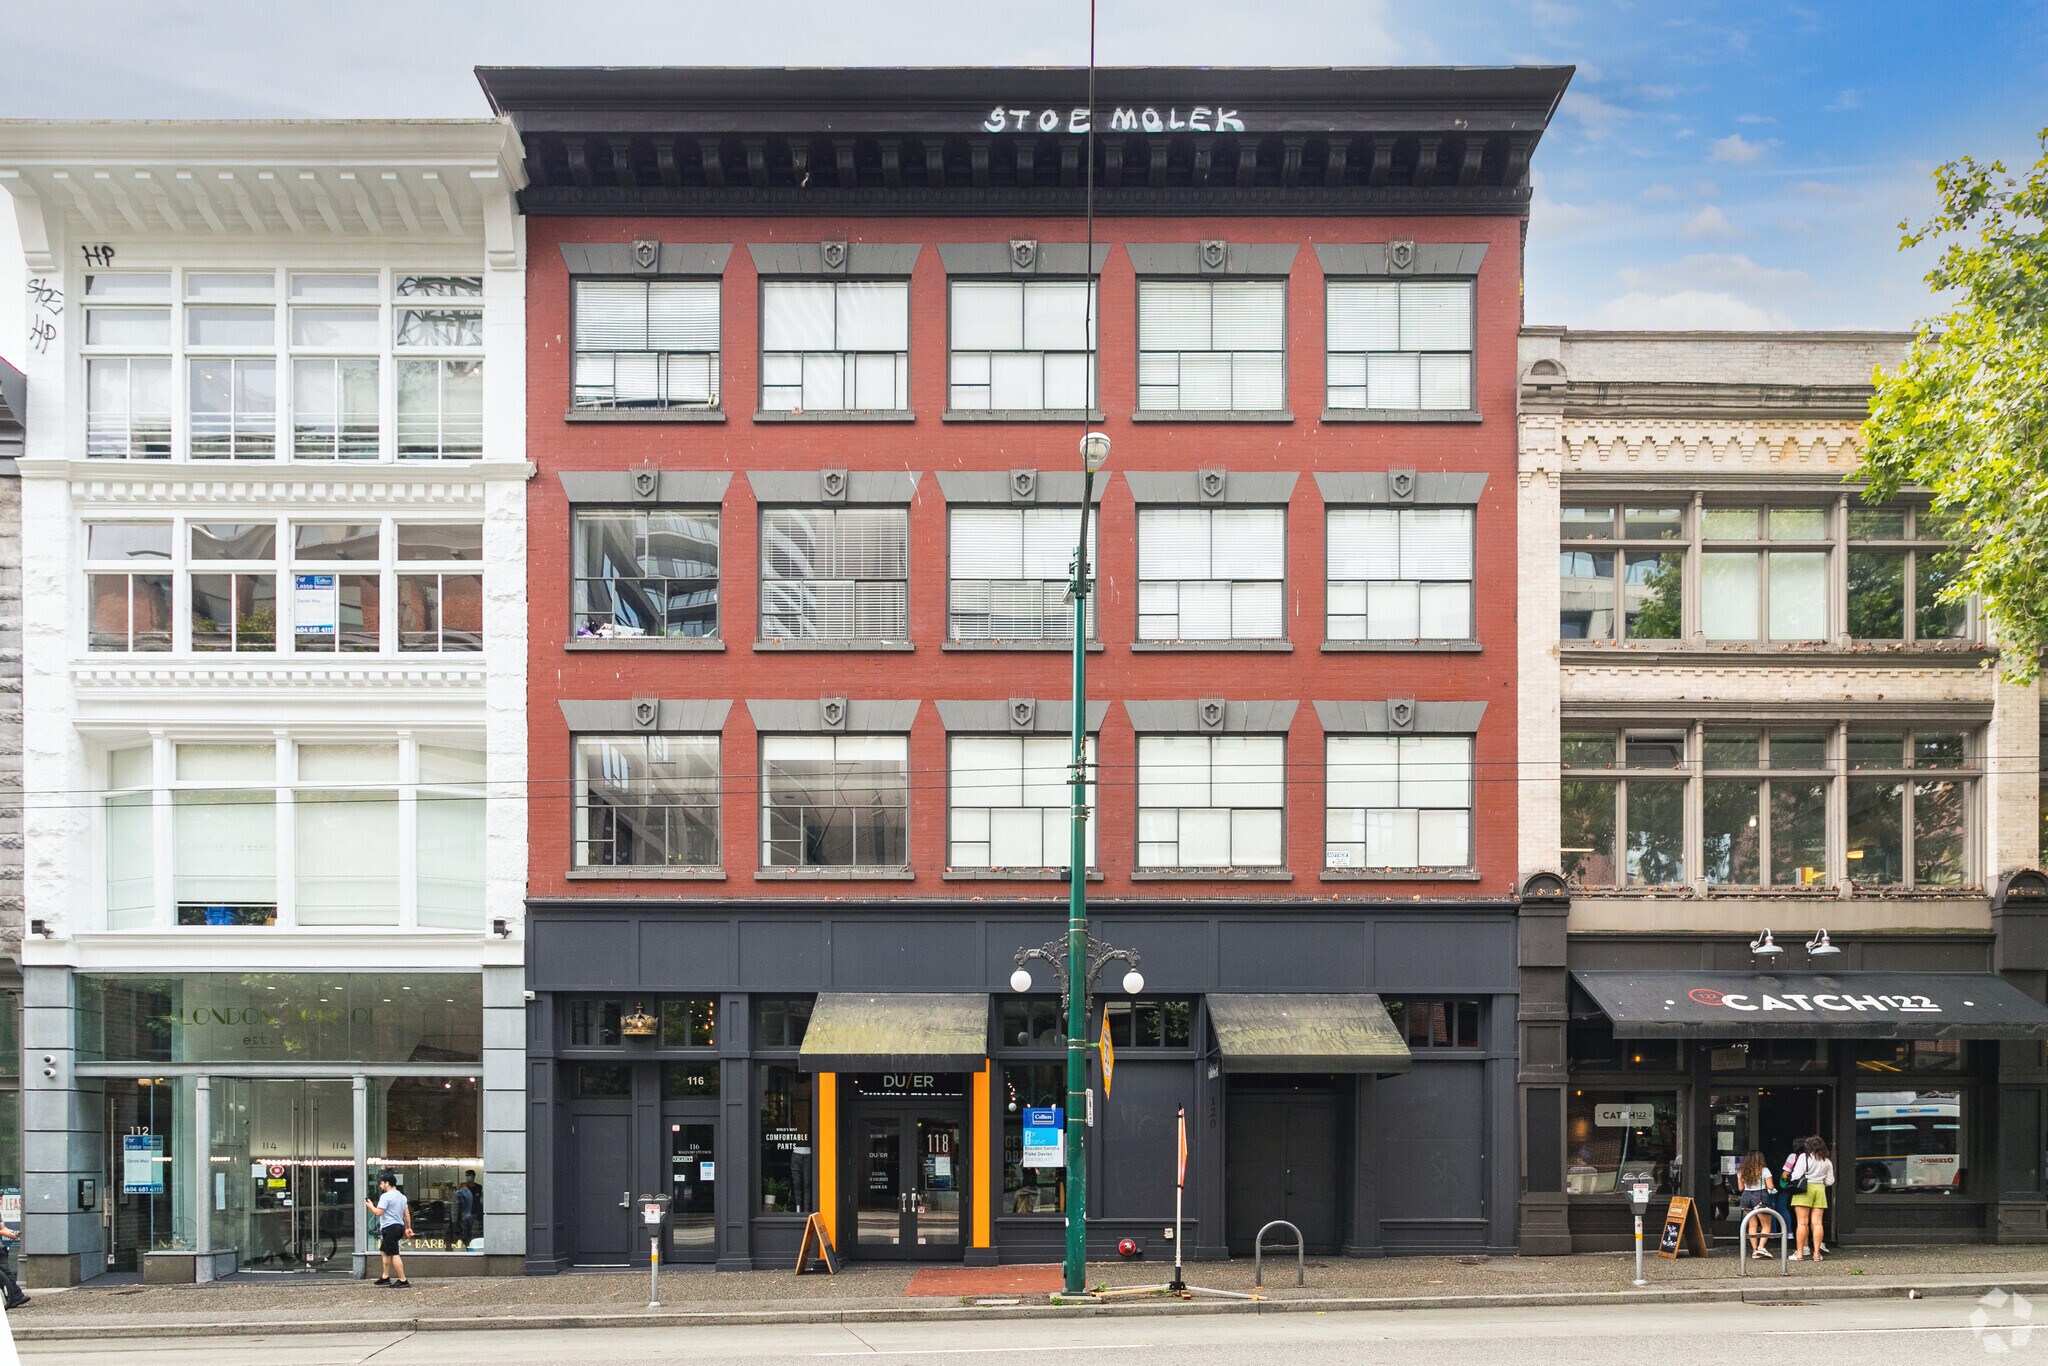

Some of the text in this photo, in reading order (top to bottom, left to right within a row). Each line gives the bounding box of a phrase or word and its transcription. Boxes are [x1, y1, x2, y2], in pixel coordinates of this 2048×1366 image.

[983, 107, 1245, 132] STOE MOLEK
[82, 245, 114, 267] HP
[687, 1076, 704, 1085] 116
[130, 1126, 149, 1135] 112
[262, 1142, 277, 1150] 114
[332, 1142, 347, 1150] 114
[927, 1133, 949, 1152] 118
